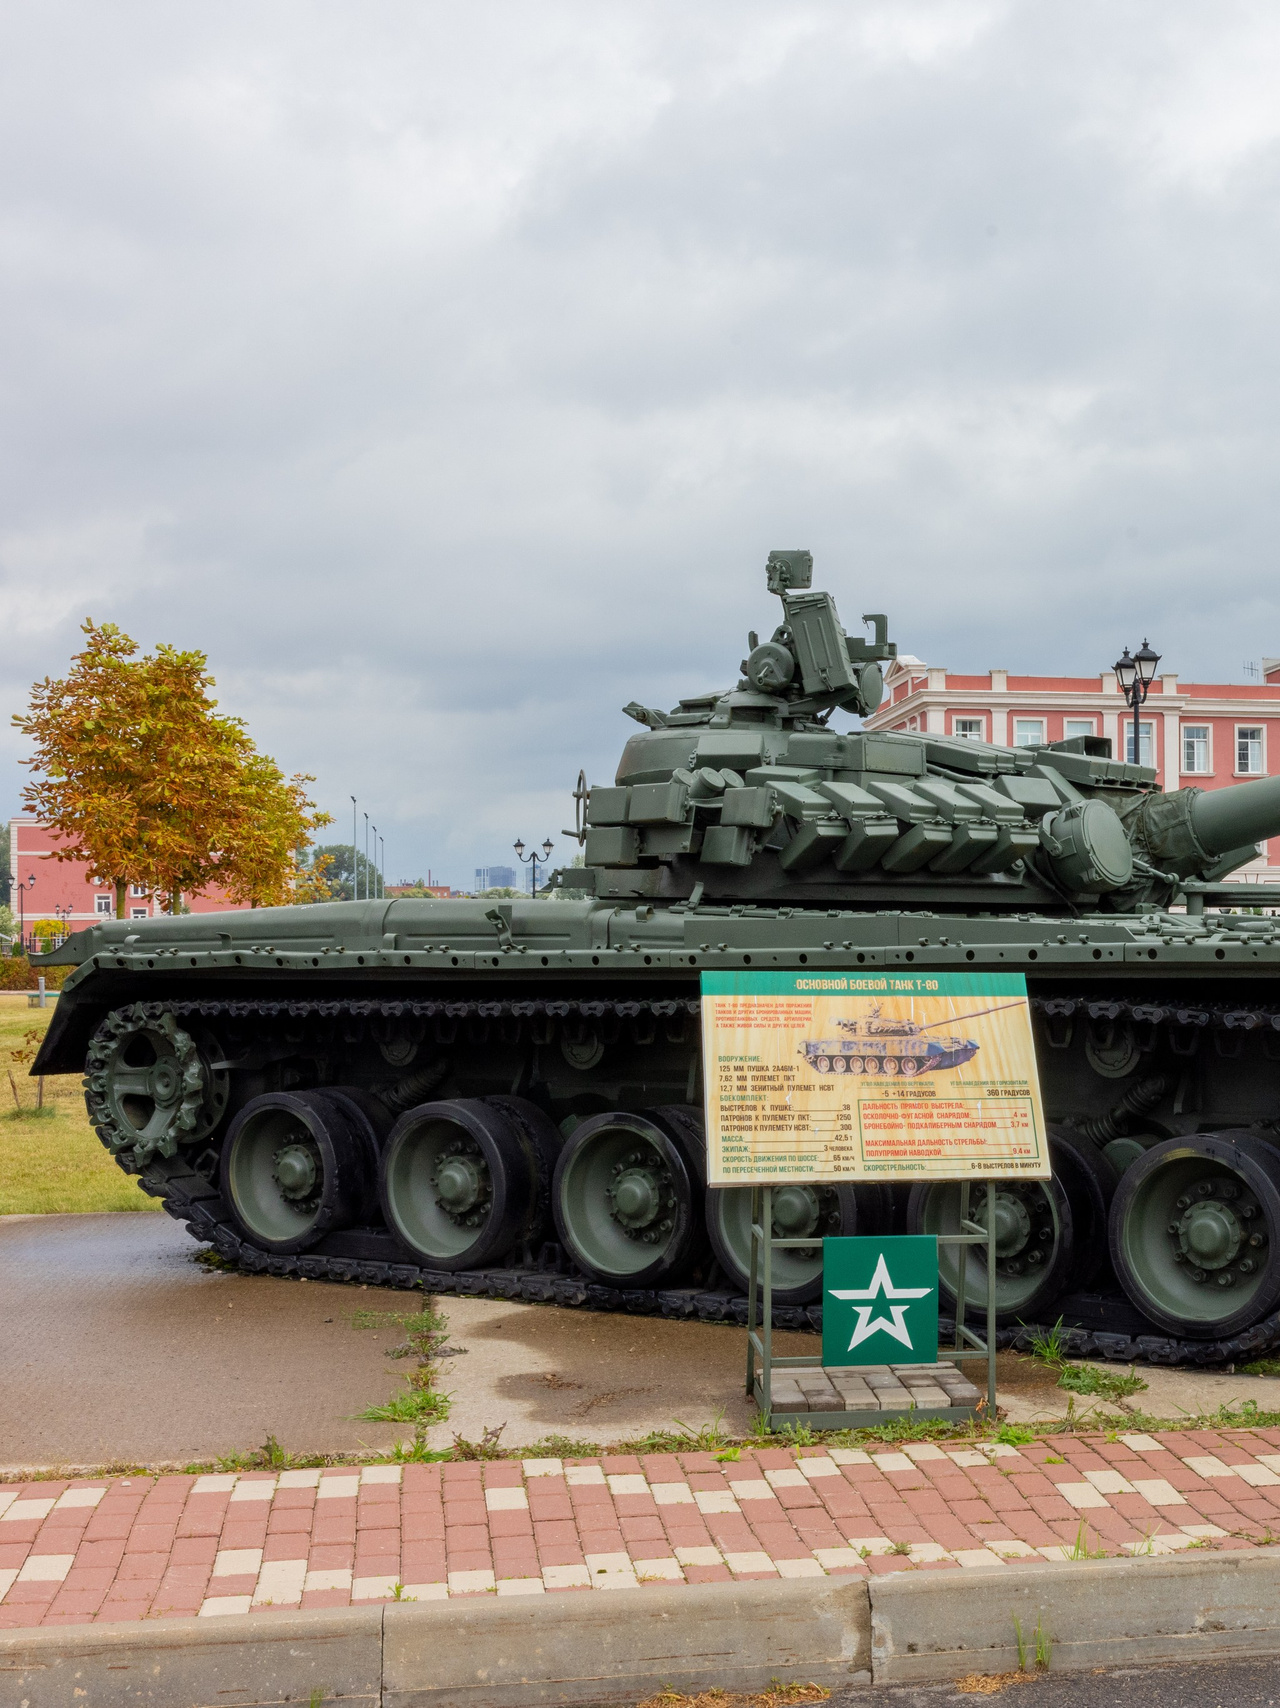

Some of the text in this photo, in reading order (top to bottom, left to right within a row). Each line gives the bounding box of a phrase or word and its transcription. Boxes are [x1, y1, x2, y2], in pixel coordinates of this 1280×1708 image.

[796, 978, 939, 990] ОСНОВНОЙ БОЕВОЙ ТАНК Т-80
[866, 1149, 908, 1157] ПОЛУПРЯМОЙ
[732, 1165, 778, 1173] ПЕРЕСЕЧЕННОЙ
